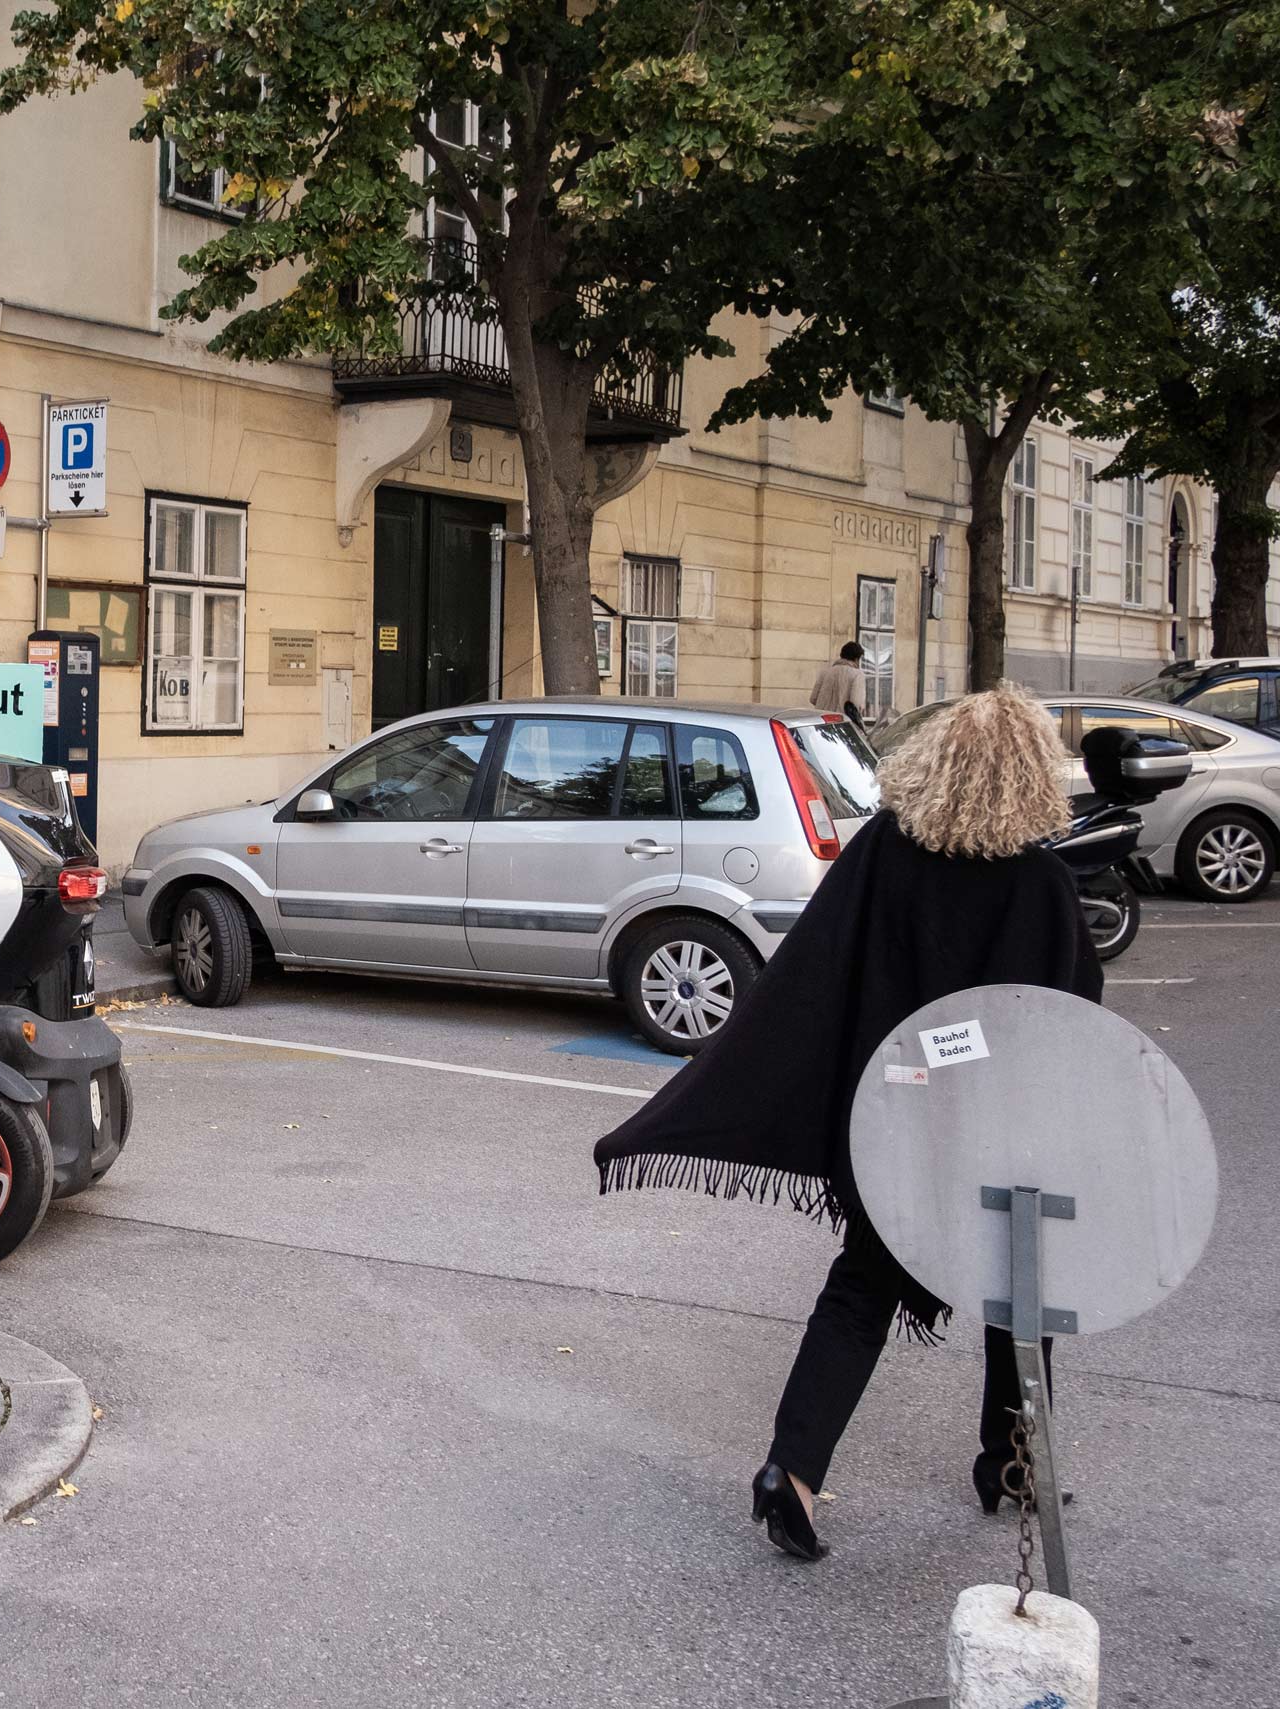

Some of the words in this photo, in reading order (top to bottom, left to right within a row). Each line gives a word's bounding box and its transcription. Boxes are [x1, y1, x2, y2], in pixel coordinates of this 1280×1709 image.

[52, 406, 105, 422] PARKTICKET
[67, 427, 88, 467] P
[51, 472, 89, 481] Parkscheine
[91, 470, 104, 479] hier
[68, 481, 86, 490] lösen
[932, 1028, 970, 1045] Bauhof
[939, 1044, 972, 1058] Baden
